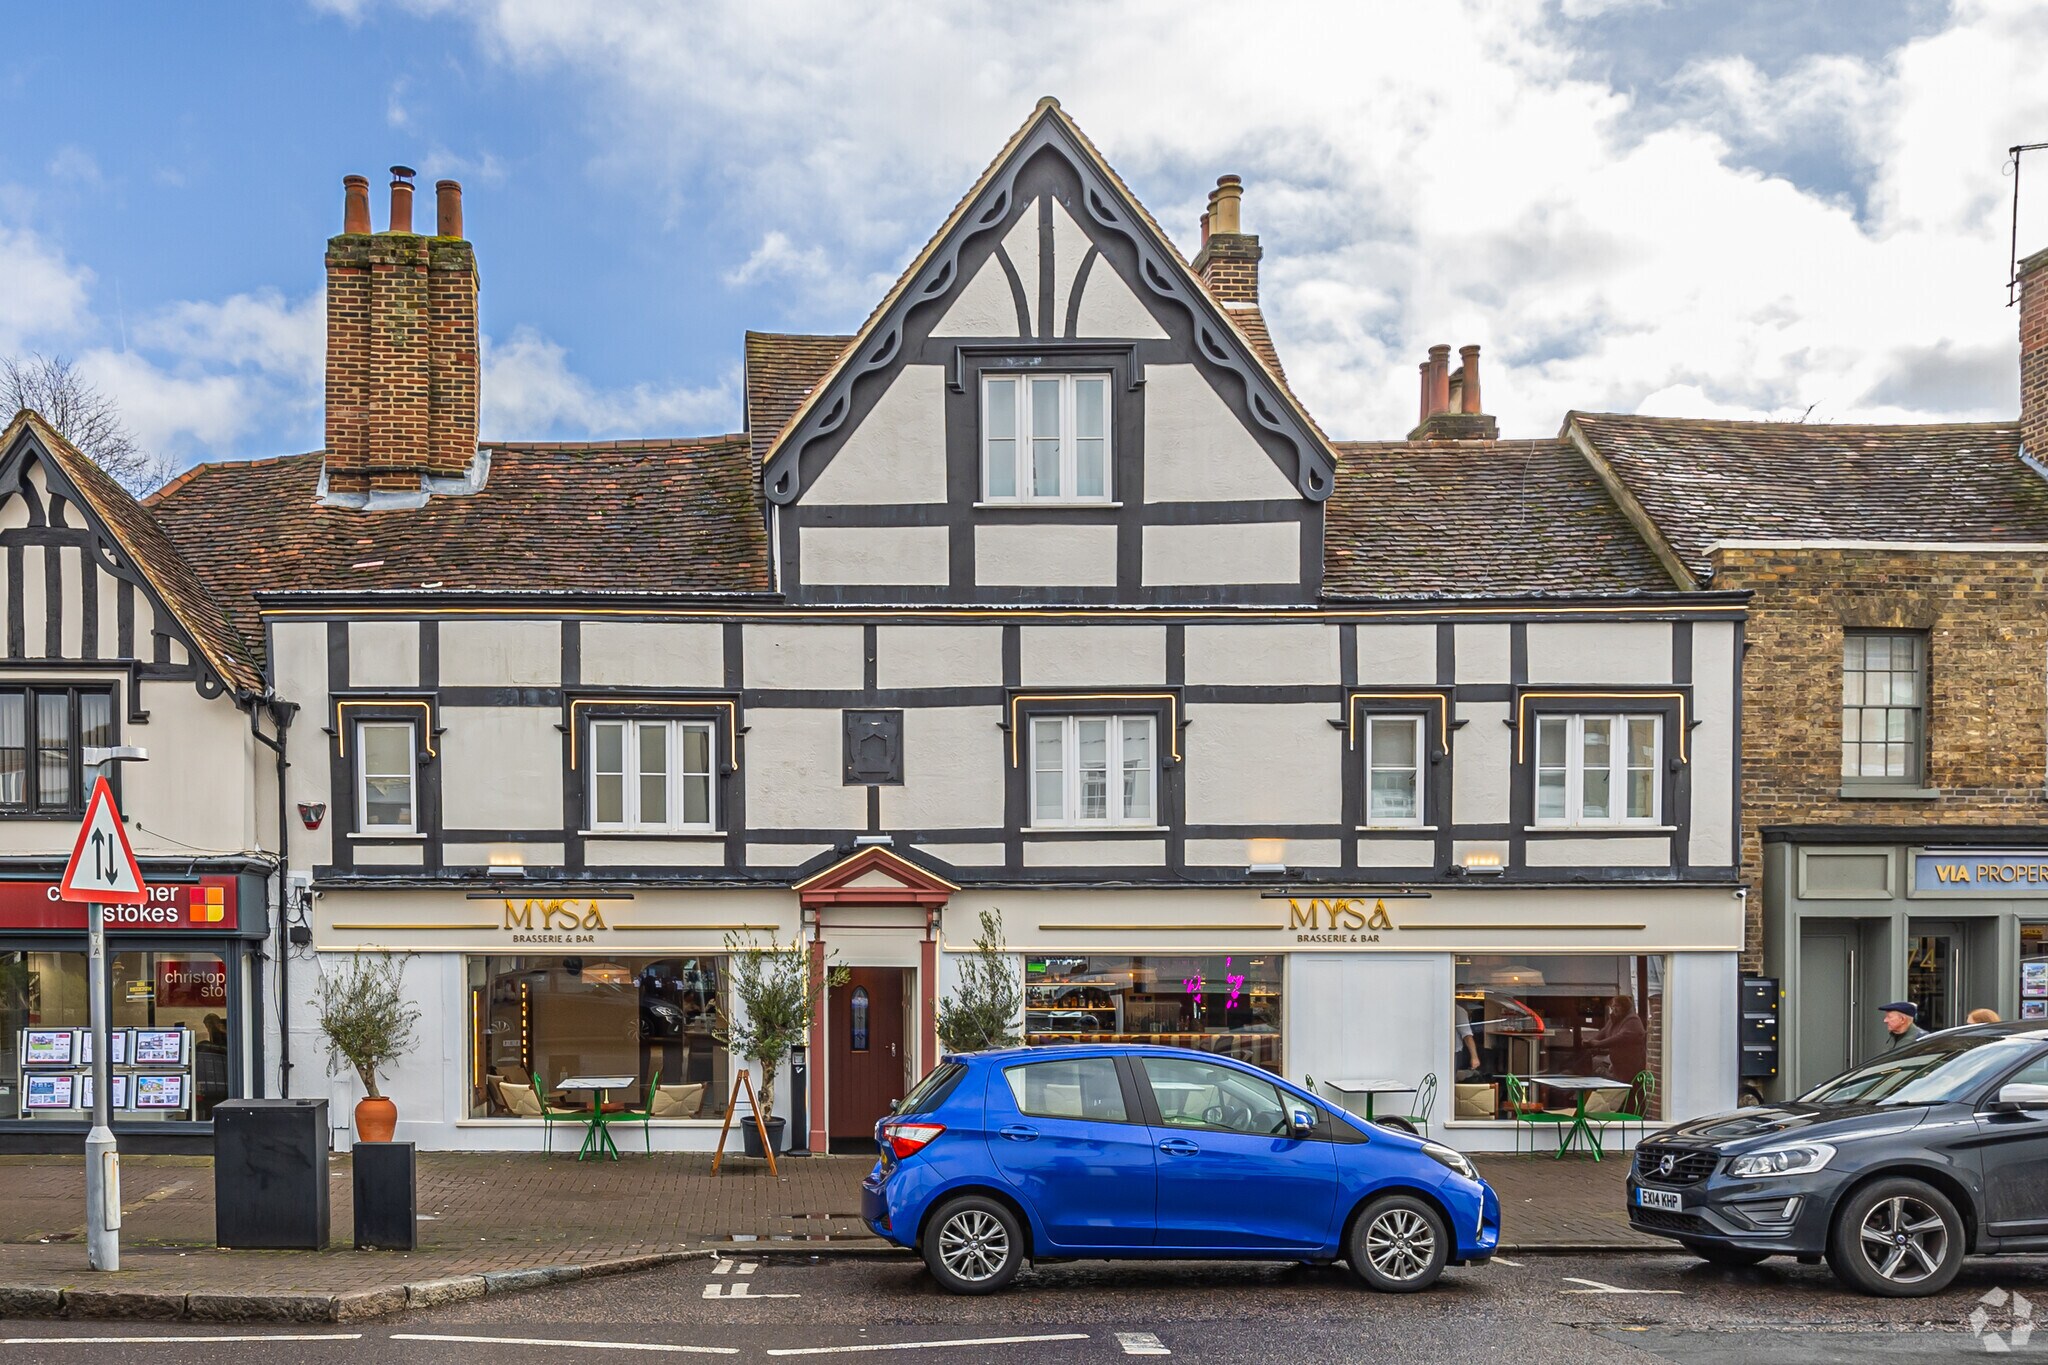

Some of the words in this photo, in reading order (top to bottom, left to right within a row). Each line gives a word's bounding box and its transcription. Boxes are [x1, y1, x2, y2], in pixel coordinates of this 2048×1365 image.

[1935, 865, 1970, 883] VIA
[1976, 864, 2048, 883] PROPER
[103, 903, 179, 923] stokes
[503, 898, 608, 931] MYSA
[1288, 898, 1393, 931] MYSA
[513, 934, 563, 943] BRASSERIE
[565, 934, 573, 943] &
[576, 934, 595, 943] BAR
[1297, 934, 1347, 943] BRASSERIE
[1350, 934, 1357, 943] &
[1361, 934, 1380, 943] BAR
[1642, 1190, 1660, 1206] EX14
[1661, 1193, 1678, 1209] KHP
